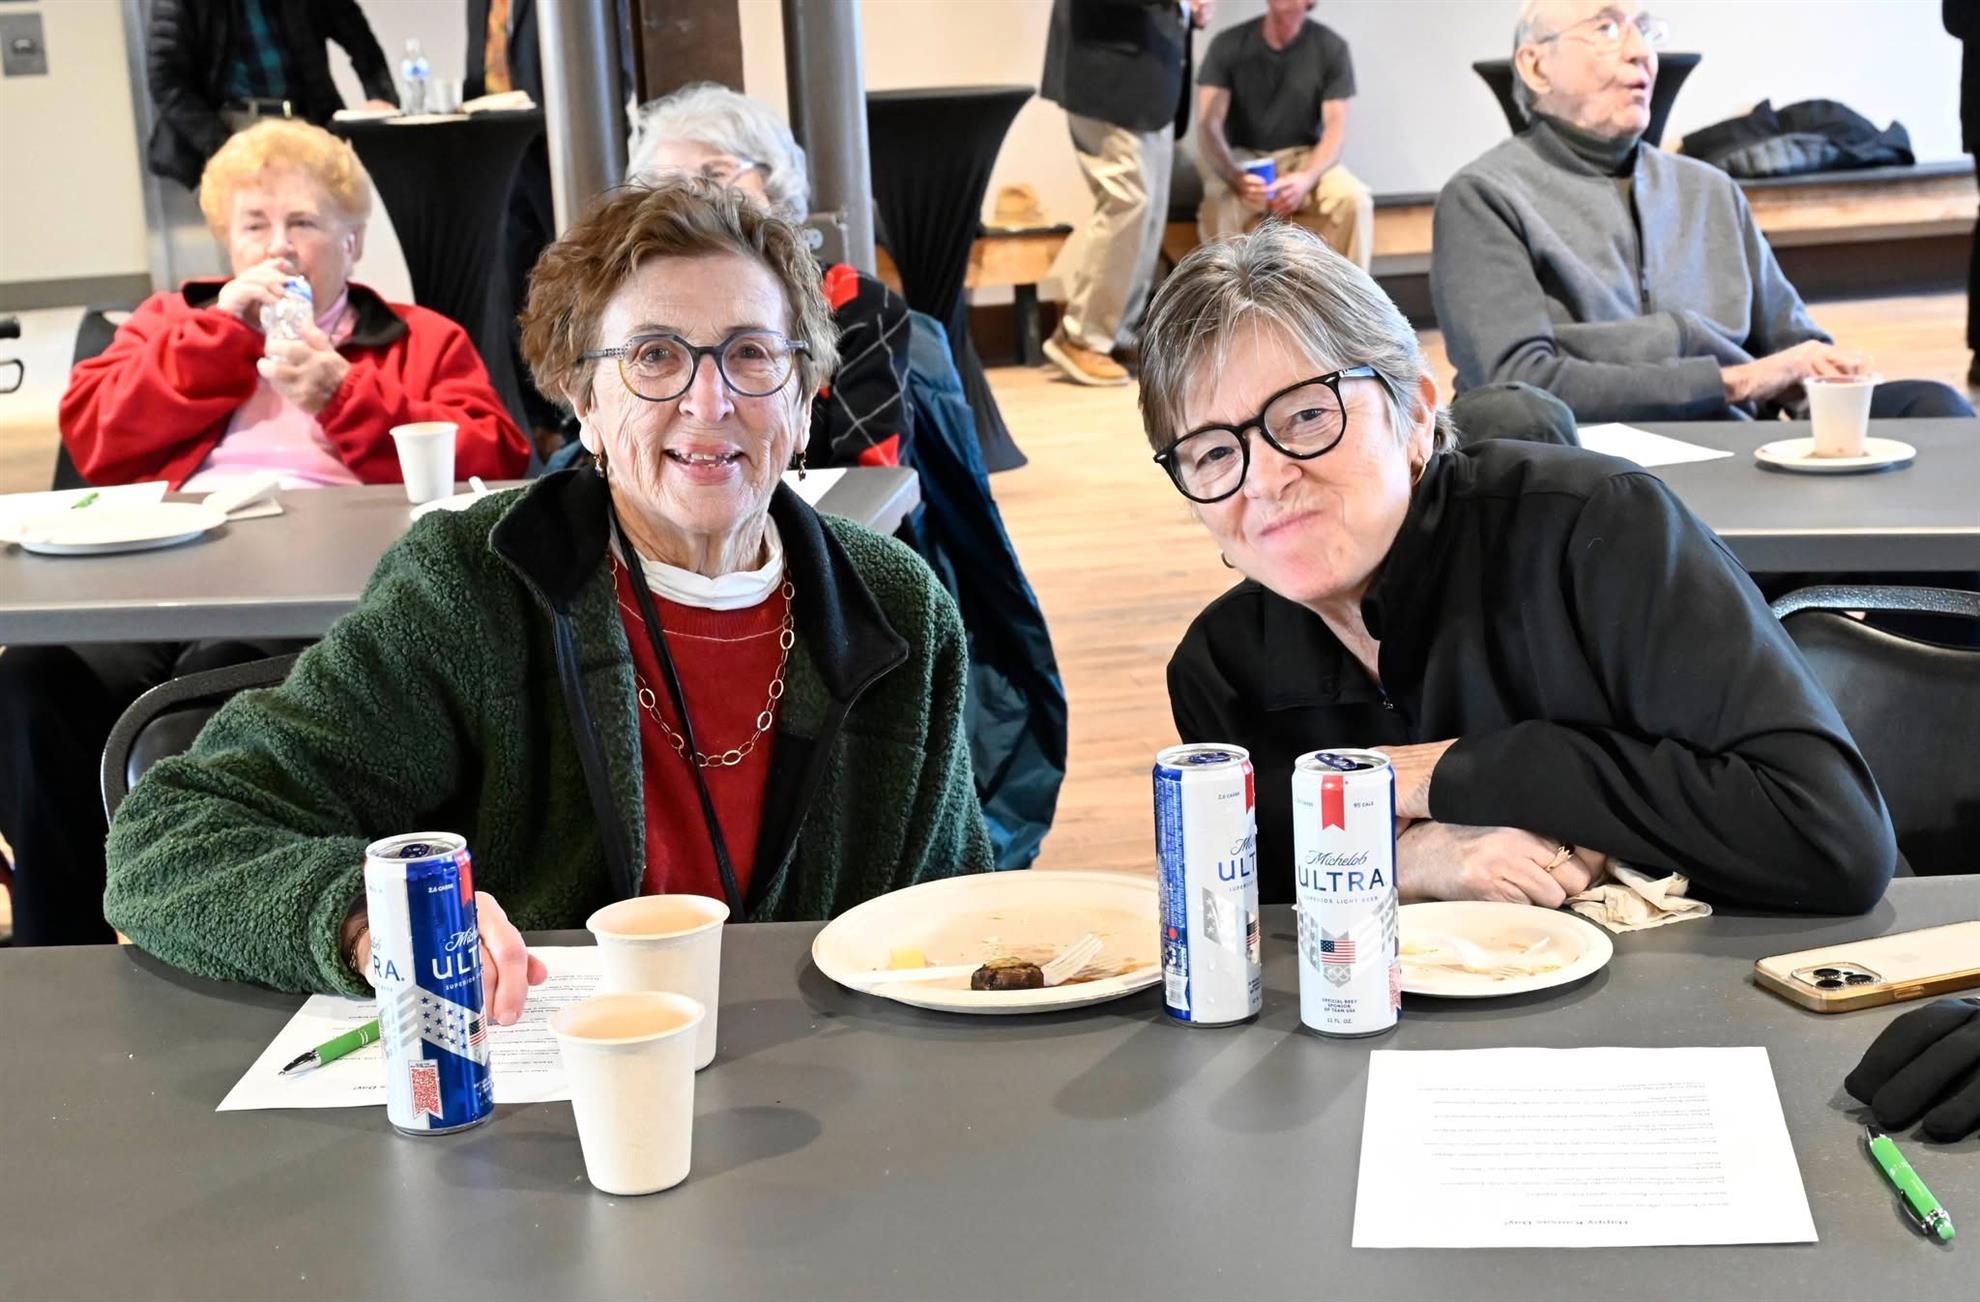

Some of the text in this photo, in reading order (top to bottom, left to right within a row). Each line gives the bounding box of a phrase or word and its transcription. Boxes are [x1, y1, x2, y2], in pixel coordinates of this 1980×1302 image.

[1218, 851, 1256, 881] ULT
[1304, 850, 1369, 866] Michelob
[1298, 865, 1385, 892] ULTRA
[432, 944, 479, 980] ULT
